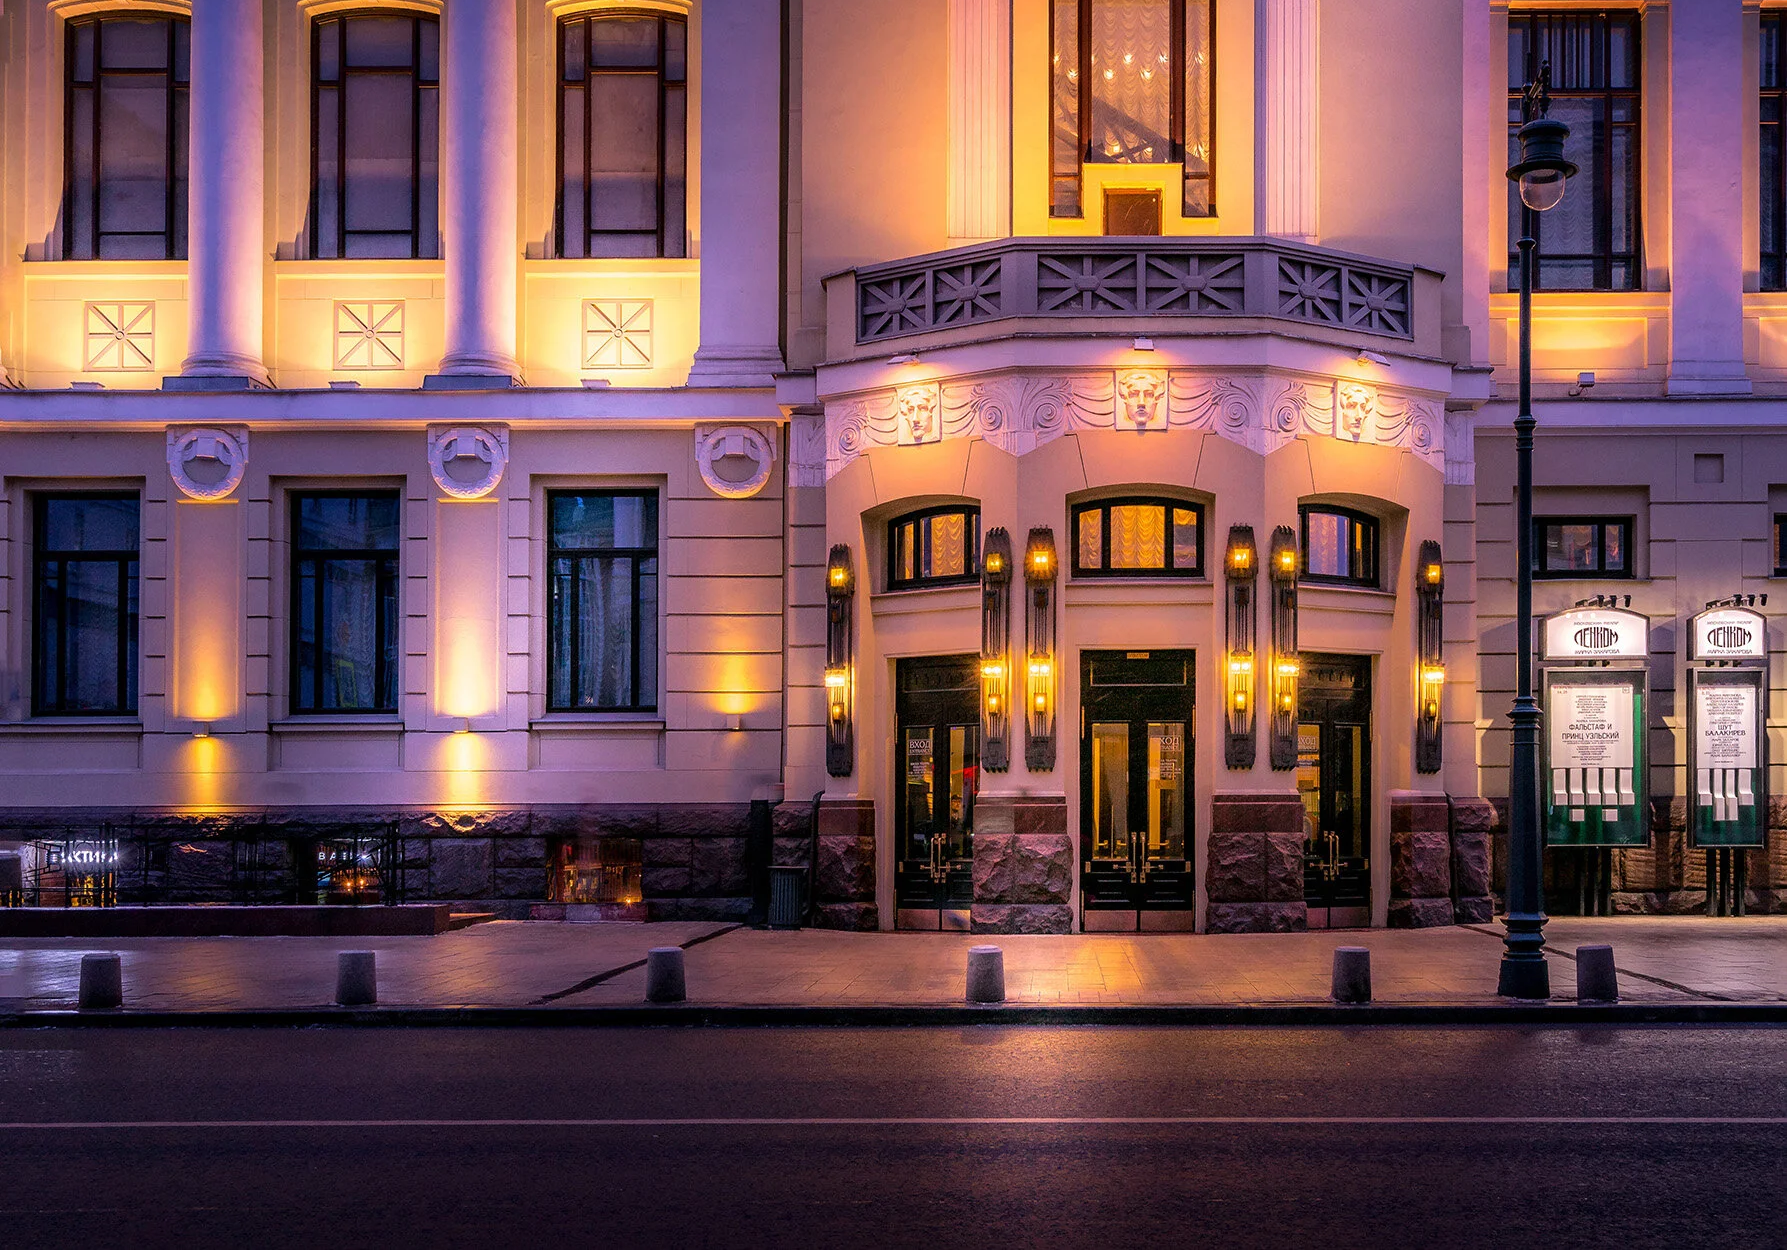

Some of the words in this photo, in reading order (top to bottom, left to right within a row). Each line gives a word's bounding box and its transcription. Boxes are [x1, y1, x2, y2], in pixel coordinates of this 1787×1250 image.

[1574, 626, 1619, 649] ЛЕНКОМ
[1707, 626, 1752, 648] ЛЕНКОМ
[1562, 732, 1584, 740] ПРИНЦ
[909, 740, 930, 748] ВХОД
